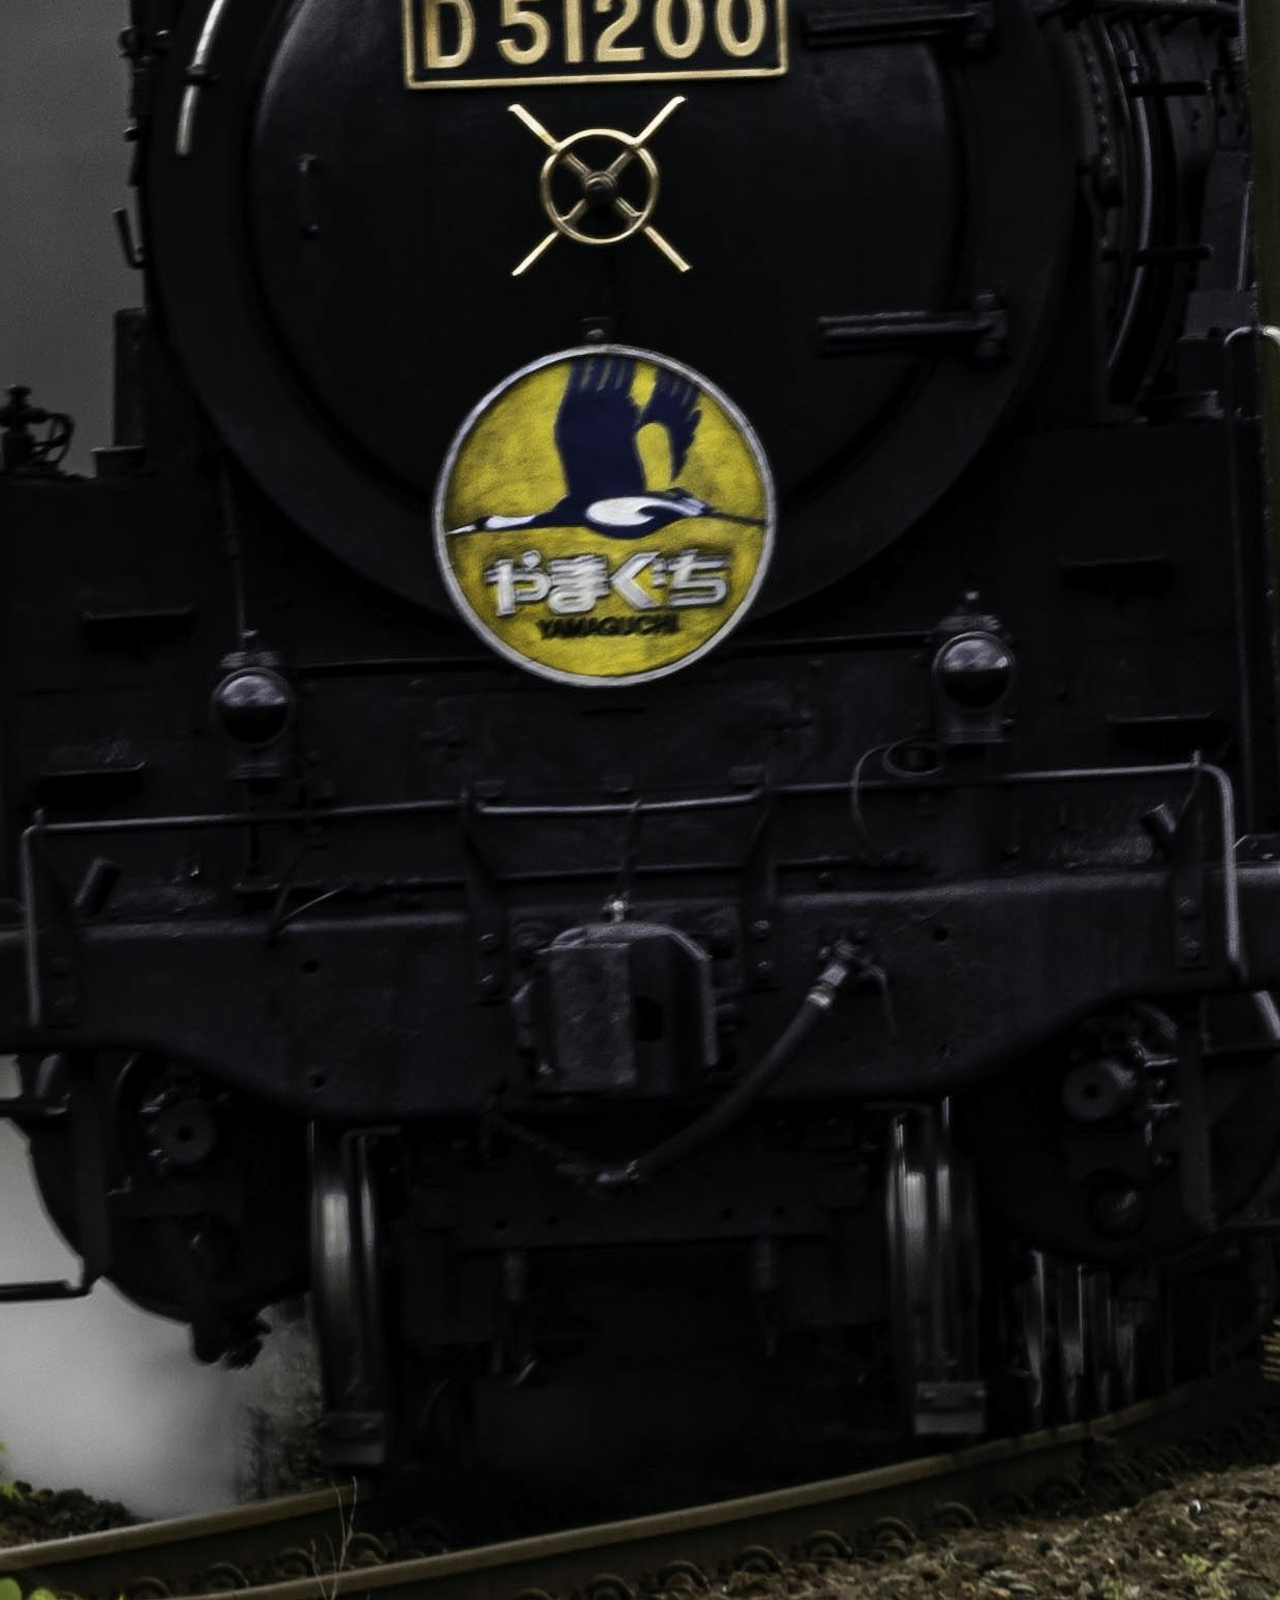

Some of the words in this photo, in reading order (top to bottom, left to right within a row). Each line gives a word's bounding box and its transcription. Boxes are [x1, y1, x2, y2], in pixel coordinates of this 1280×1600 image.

[483, 549, 729, 617] やまぐち
[535, 613, 681, 640] YAMAGUCHI
